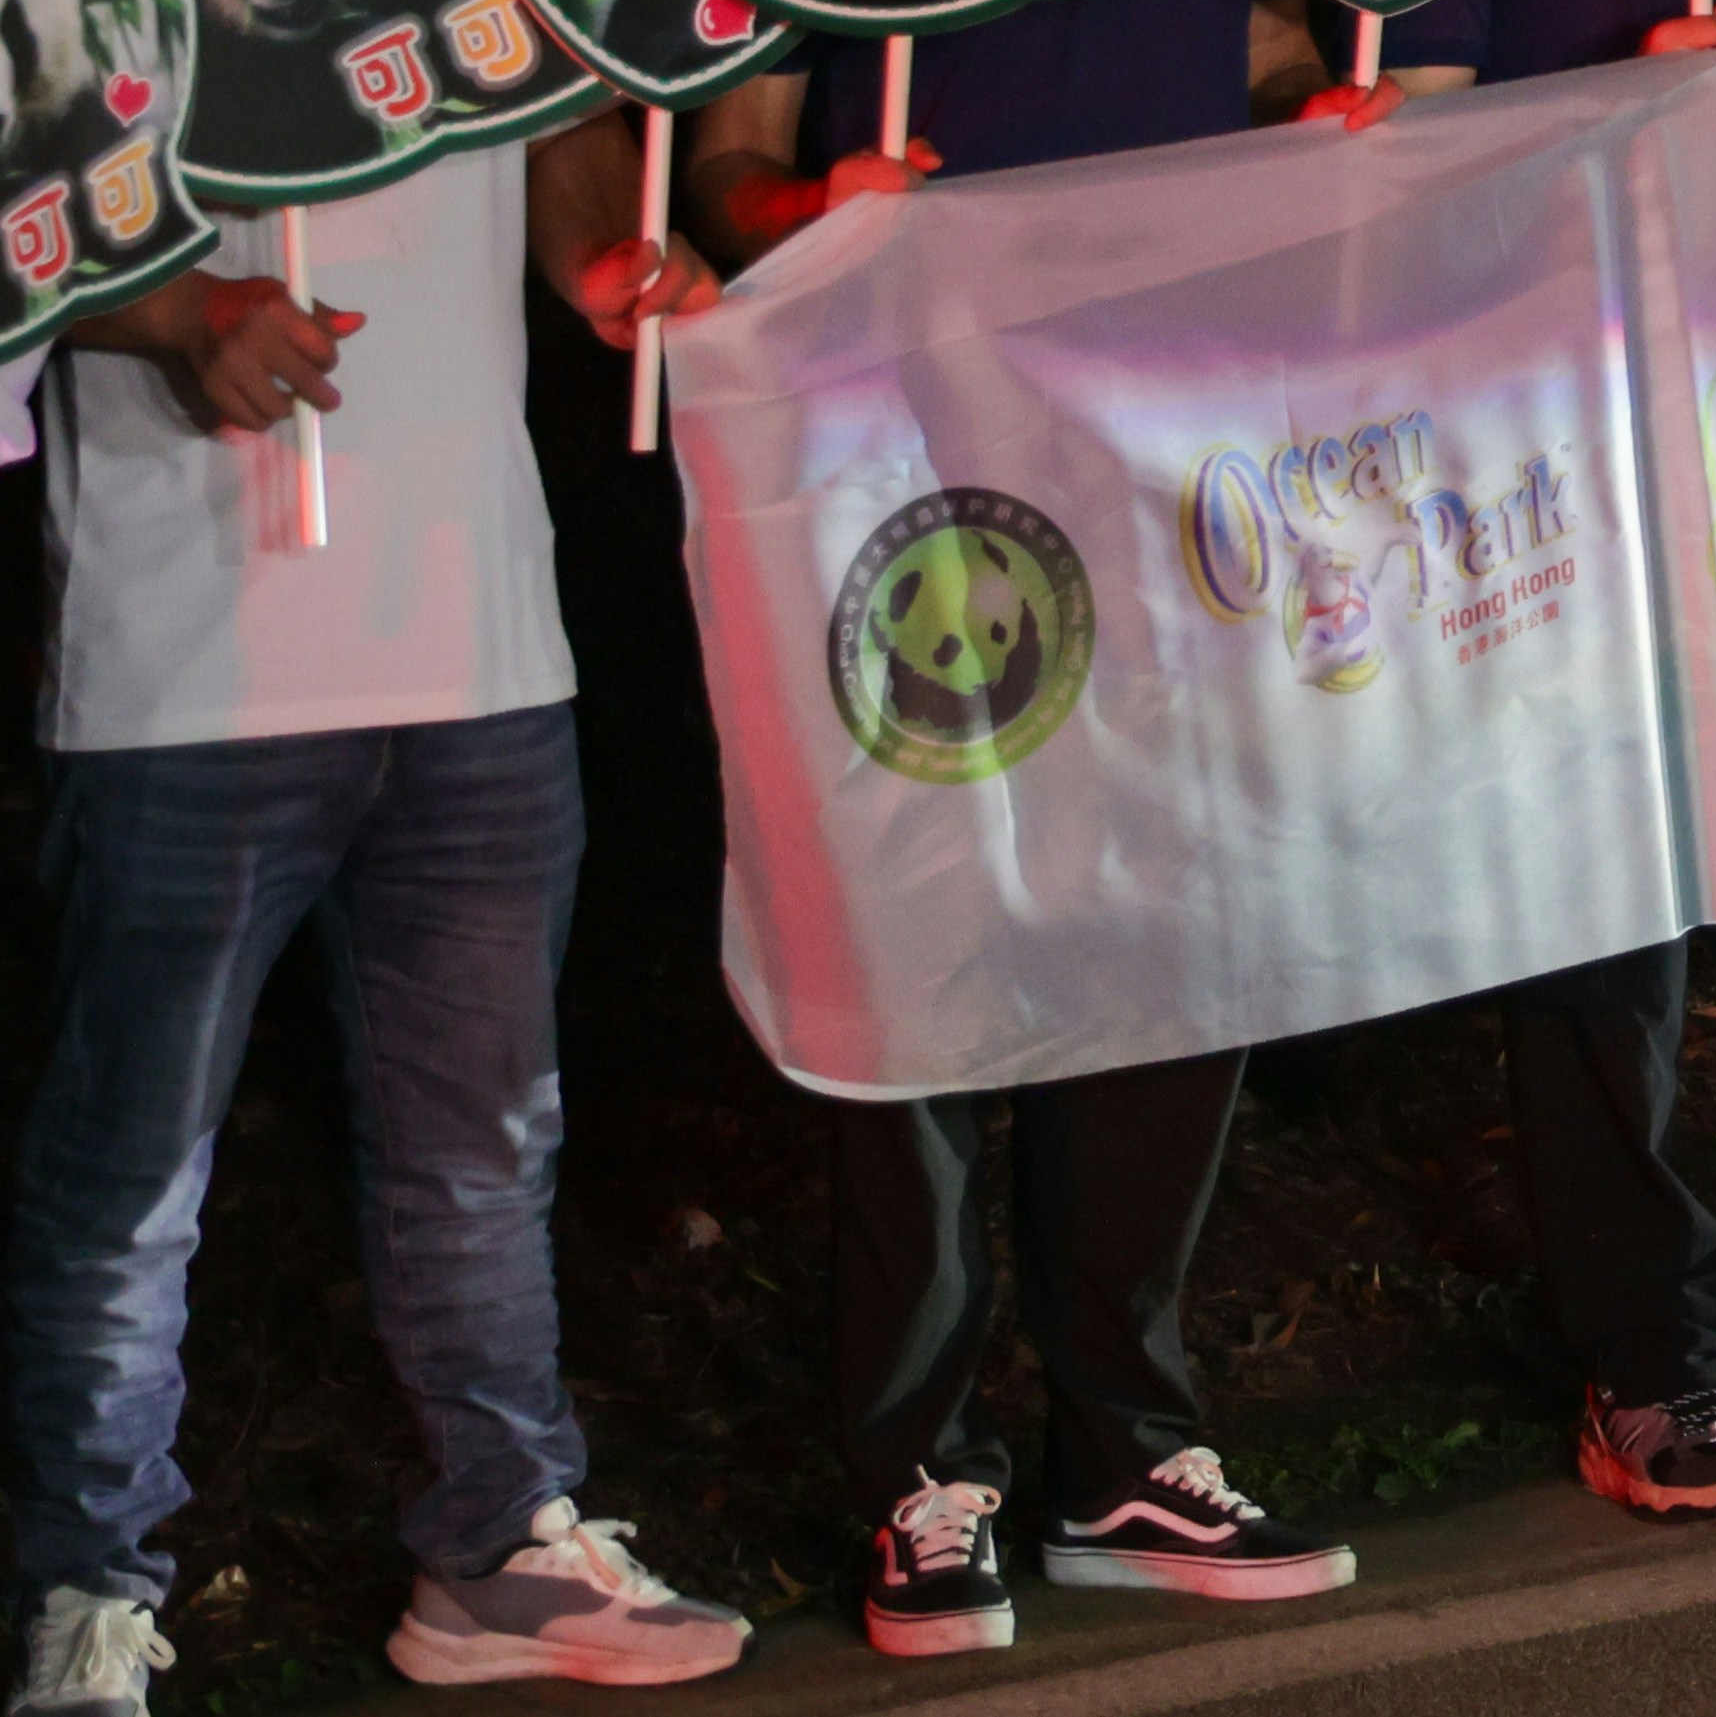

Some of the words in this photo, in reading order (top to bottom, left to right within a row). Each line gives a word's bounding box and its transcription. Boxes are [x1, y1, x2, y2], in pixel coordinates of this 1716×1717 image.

[2, 139, 157, 283] 可可
[1185, 409, 1436, 619] Ocean
[1402, 454, 1578, 612] Park
[1440, 591, 1506, 641] Hong
[1511, 558, 1576, 605] Kong
